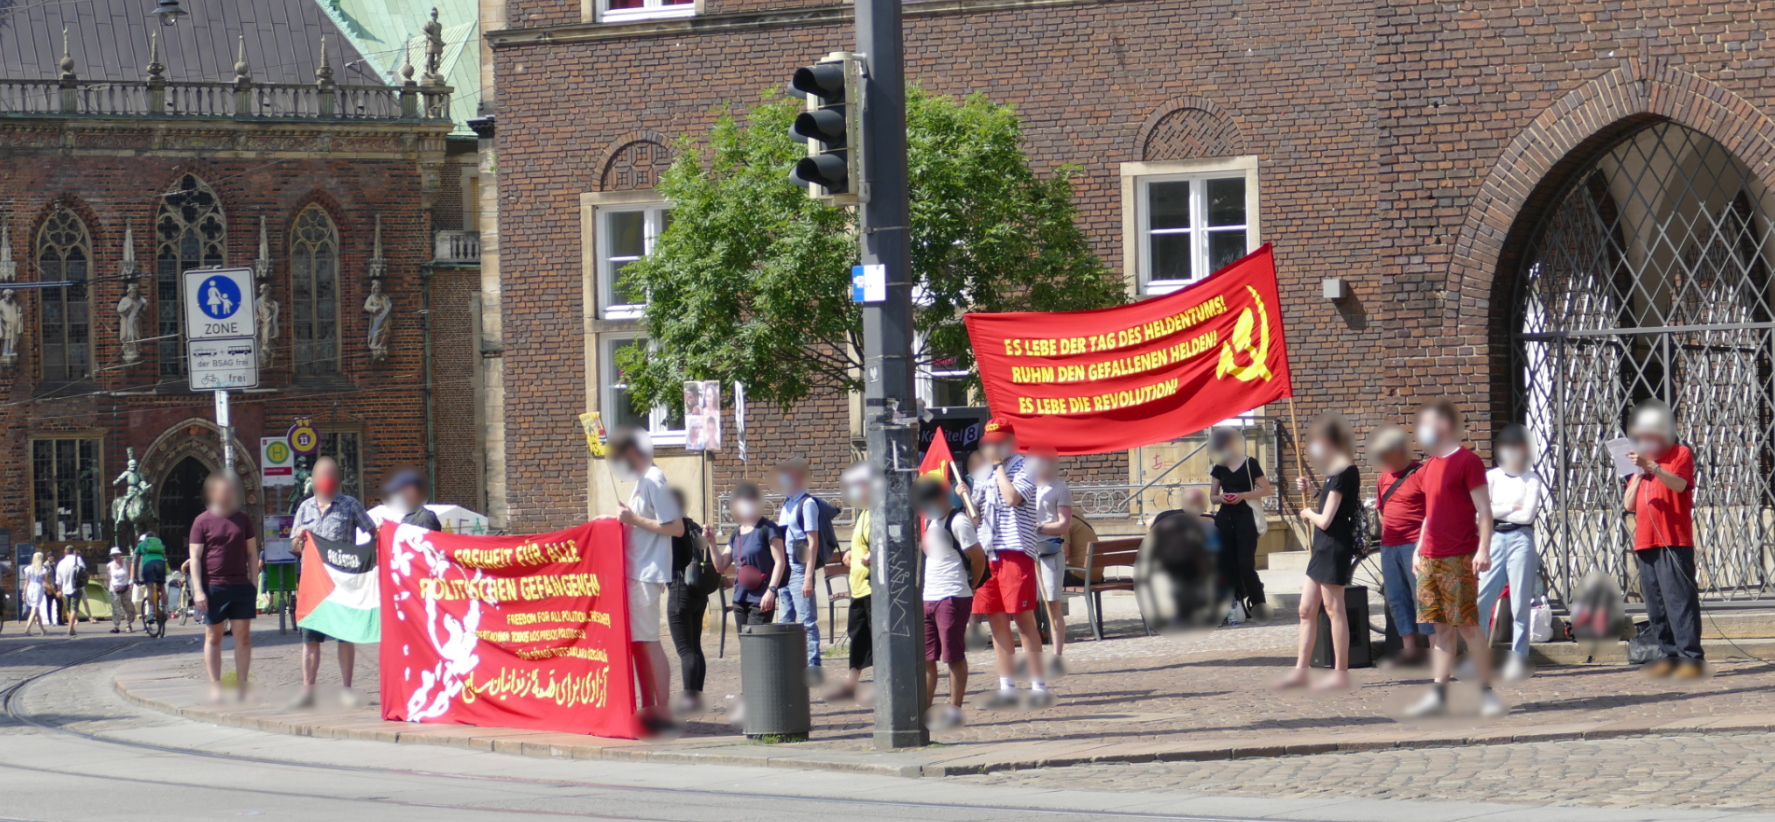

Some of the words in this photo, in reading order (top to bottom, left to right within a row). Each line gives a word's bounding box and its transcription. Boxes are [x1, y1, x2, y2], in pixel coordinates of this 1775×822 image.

[204, 322, 239, 335] ZONE
[1004, 339, 1023, 356] ES
[1025, 339, 1057, 356] LEBE
[1060, 337, 1086, 354] DER
[1089, 332, 1115, 351] TAG
[1118, 327, 1142, 348] DES
[1144, 295, 1228, 341] HELDENTUMS!
[197, 360, 210, 368] der
[212, 359, 234, 367] BSAG
[236, 358, 249, 367] frei
[1011, 366, 1054, 383] RUHM
[1058, 365, 1085, 382] DEN
[1088, 353, 1168, 380] GEFALLENEN
[1170, 330, 1218, 363] HELDEN!
[228, 373, 246, 383] frei
[1019, 397, 1034, 414] ES
[1037, 396, 1066, 415] LEBE
[1069, 396, 1091, 413] DIE
[1094, 378, 1179, 411] REVOLUTION!
[921, 429, 963, 442] Kaitel
[967, 427, 976, 441] 8
[272, 446, 283, 460] H
[454, 548, 514, 569] FREIHEIT
[515, 540, 545, 566] FÜR
[547, 540, 581, 565] ALLE
[506, 612, 537, 625] FREEDOM
[537, 611, 550, 624] FOR
[550, 610, 561, 622] ALL
